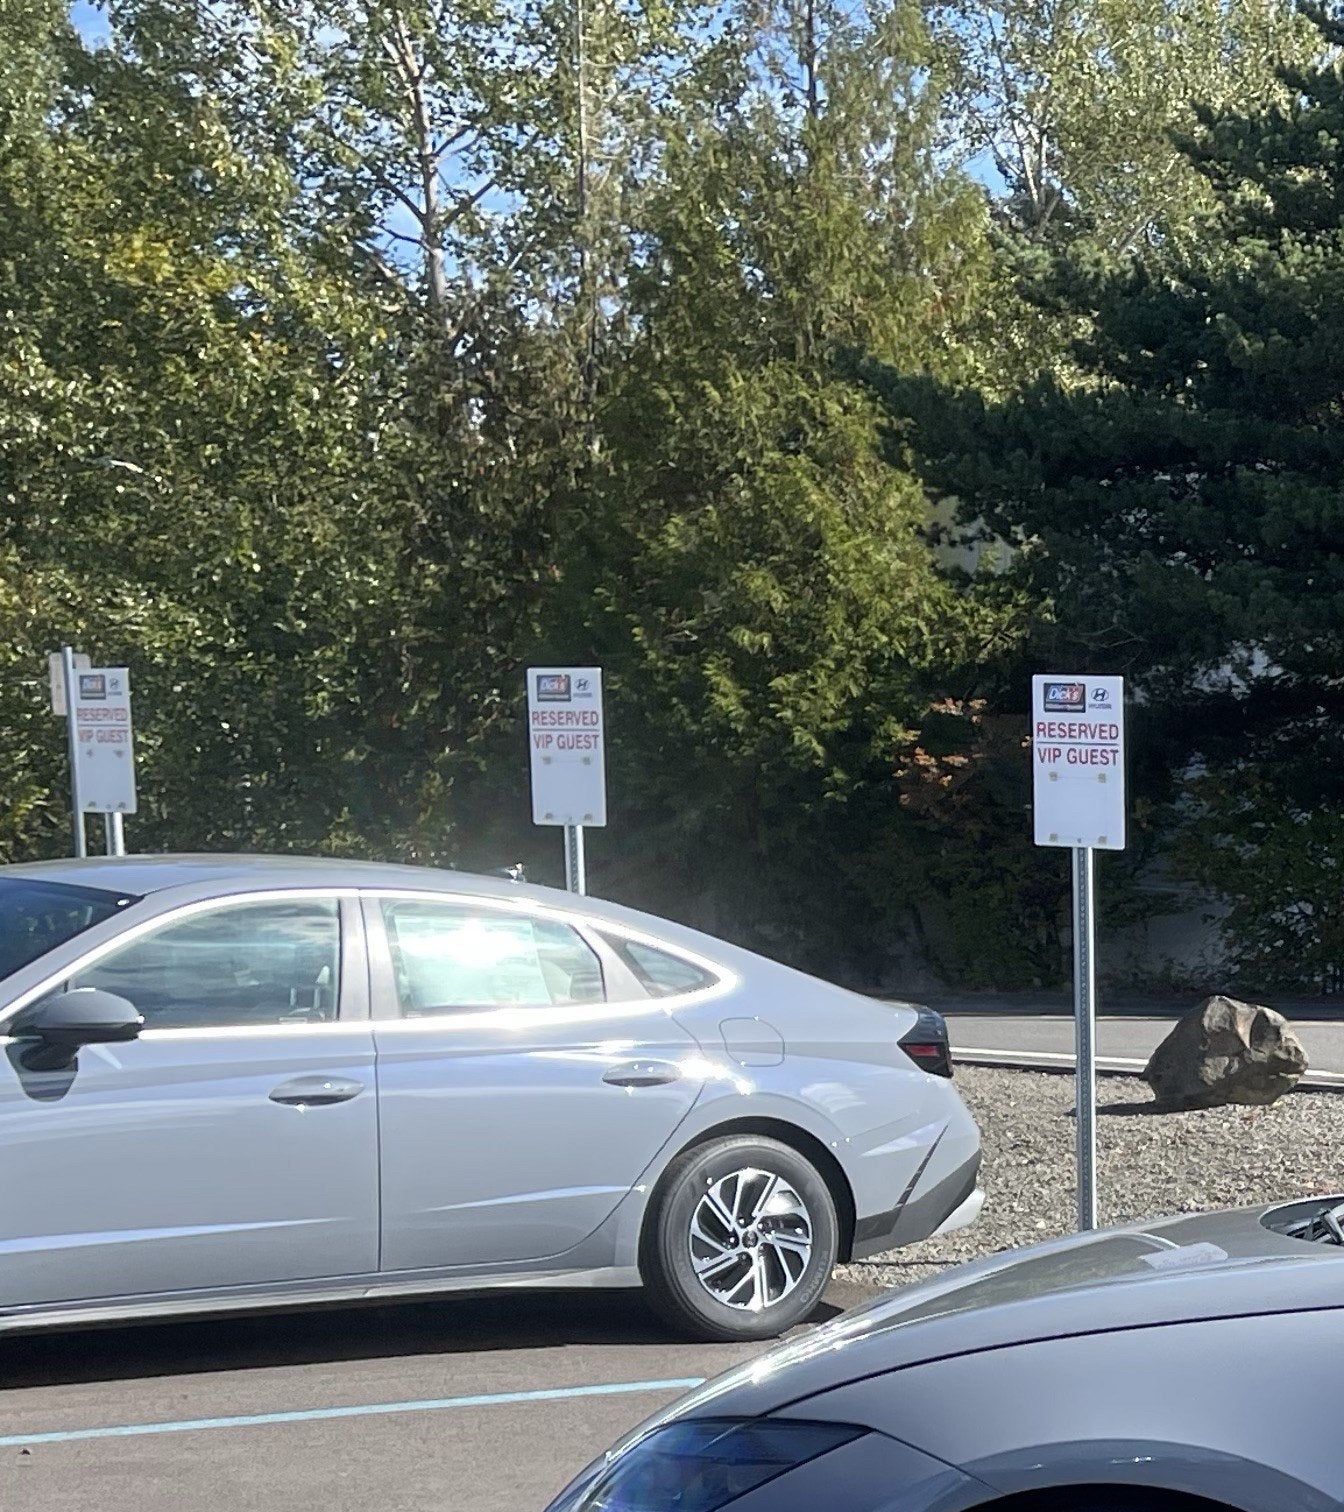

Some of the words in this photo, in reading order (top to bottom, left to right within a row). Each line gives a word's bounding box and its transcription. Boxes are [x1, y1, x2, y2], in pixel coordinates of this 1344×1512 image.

[532, 710, 599, 726] RESERVED
[1036, 722, 1119, 740] RESERVED
[534, 734, 553, 750] VIP
[556, 734, 600, 750] GUEST
[1038, 747, 1062, 764] VIP
[1066, 747, 1119, 766] GUEST
